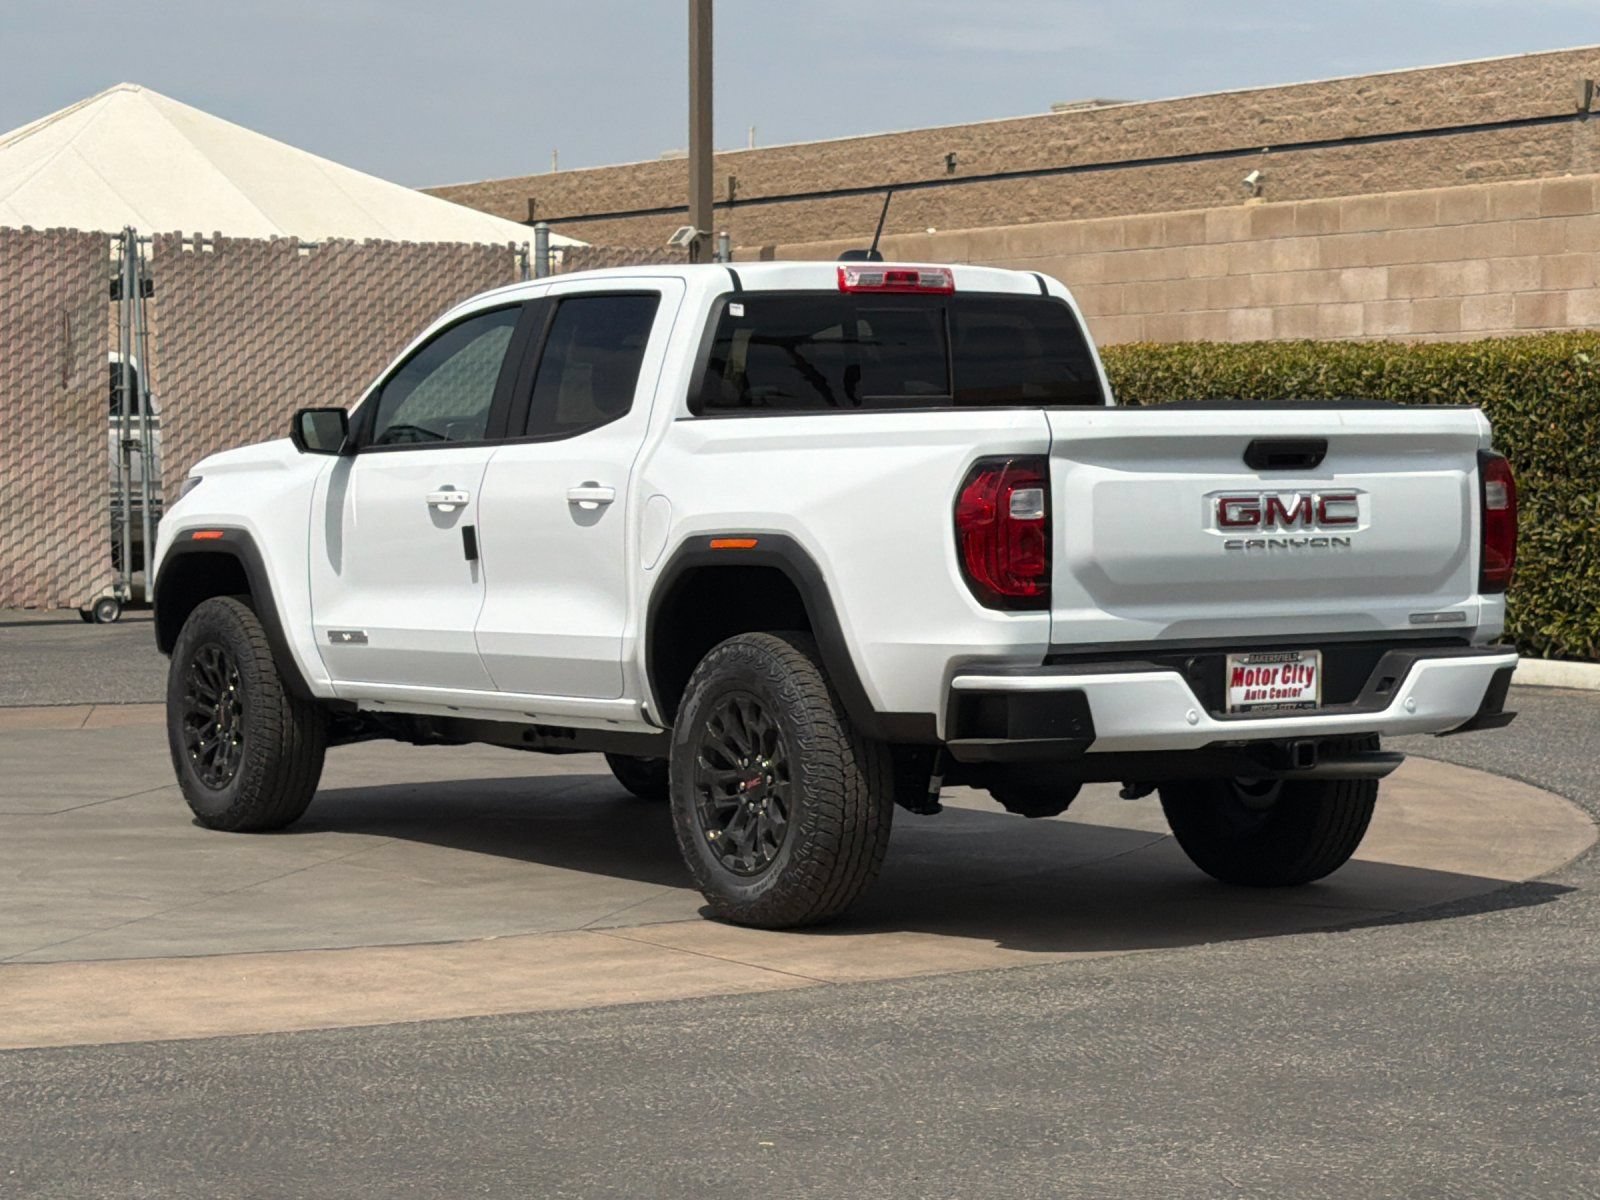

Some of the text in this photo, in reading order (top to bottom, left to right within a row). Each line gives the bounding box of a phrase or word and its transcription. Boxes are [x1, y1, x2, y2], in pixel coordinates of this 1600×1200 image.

[1217, 492, 1358, 528] GMC
[1223, 537, 1351, 550] CANYON
[1230, 663, 1315, 688] Motor City
[1244, 687, 1303, 700] Auto Center
